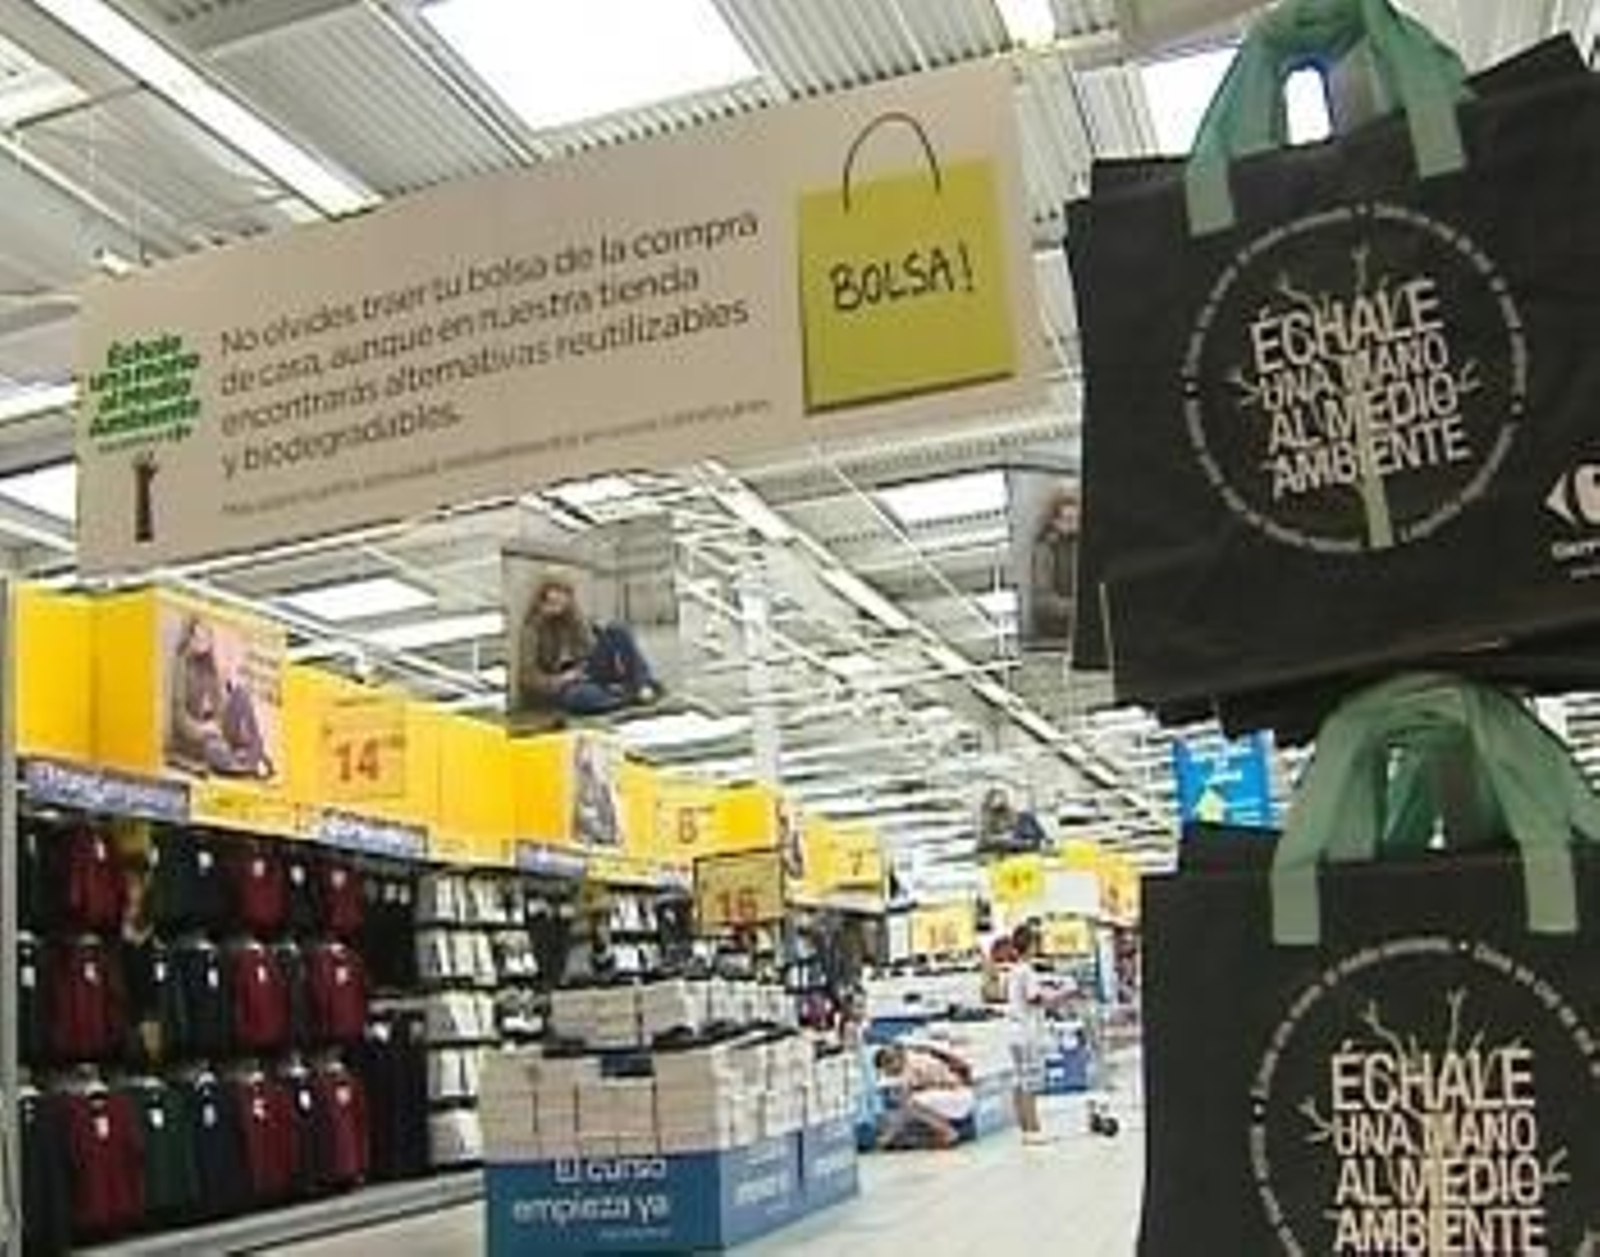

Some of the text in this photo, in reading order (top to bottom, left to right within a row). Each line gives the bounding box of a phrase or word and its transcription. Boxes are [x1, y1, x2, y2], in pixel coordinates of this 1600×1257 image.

[221, 211, 759, 356] No olvides traer tu bolsa de la compra
[221, 369, 255, 397] de
[330, 323, 433, 369] aunque
[436, 314, 474, 343] en
[479, 287, 593, 331] nuestra
[599, 263, 699, 309] tienda
[384, 342, 550, 398] alternativas
[554, 298, 750, 357] reutilizables
[1250, 279, 1444, 374] ÉCHALE
[1260, 332, 1450, 412] UNA MANO
[1268, 372, 1458, 456] AL MEDIO
[221, 450, 237, 480] y
[1270, 416, 1471, 500] AMBIENTE
[333, 736, 380, 783] 14
[1331, 1038, 1536, 1111] ÉCHALE
[1334, 1110, 1537, 1156] UNA MANO
[513, 1193, 671, 1229] empieza ya
[1336, 1152, 1541, 1206] AL MEDIO
